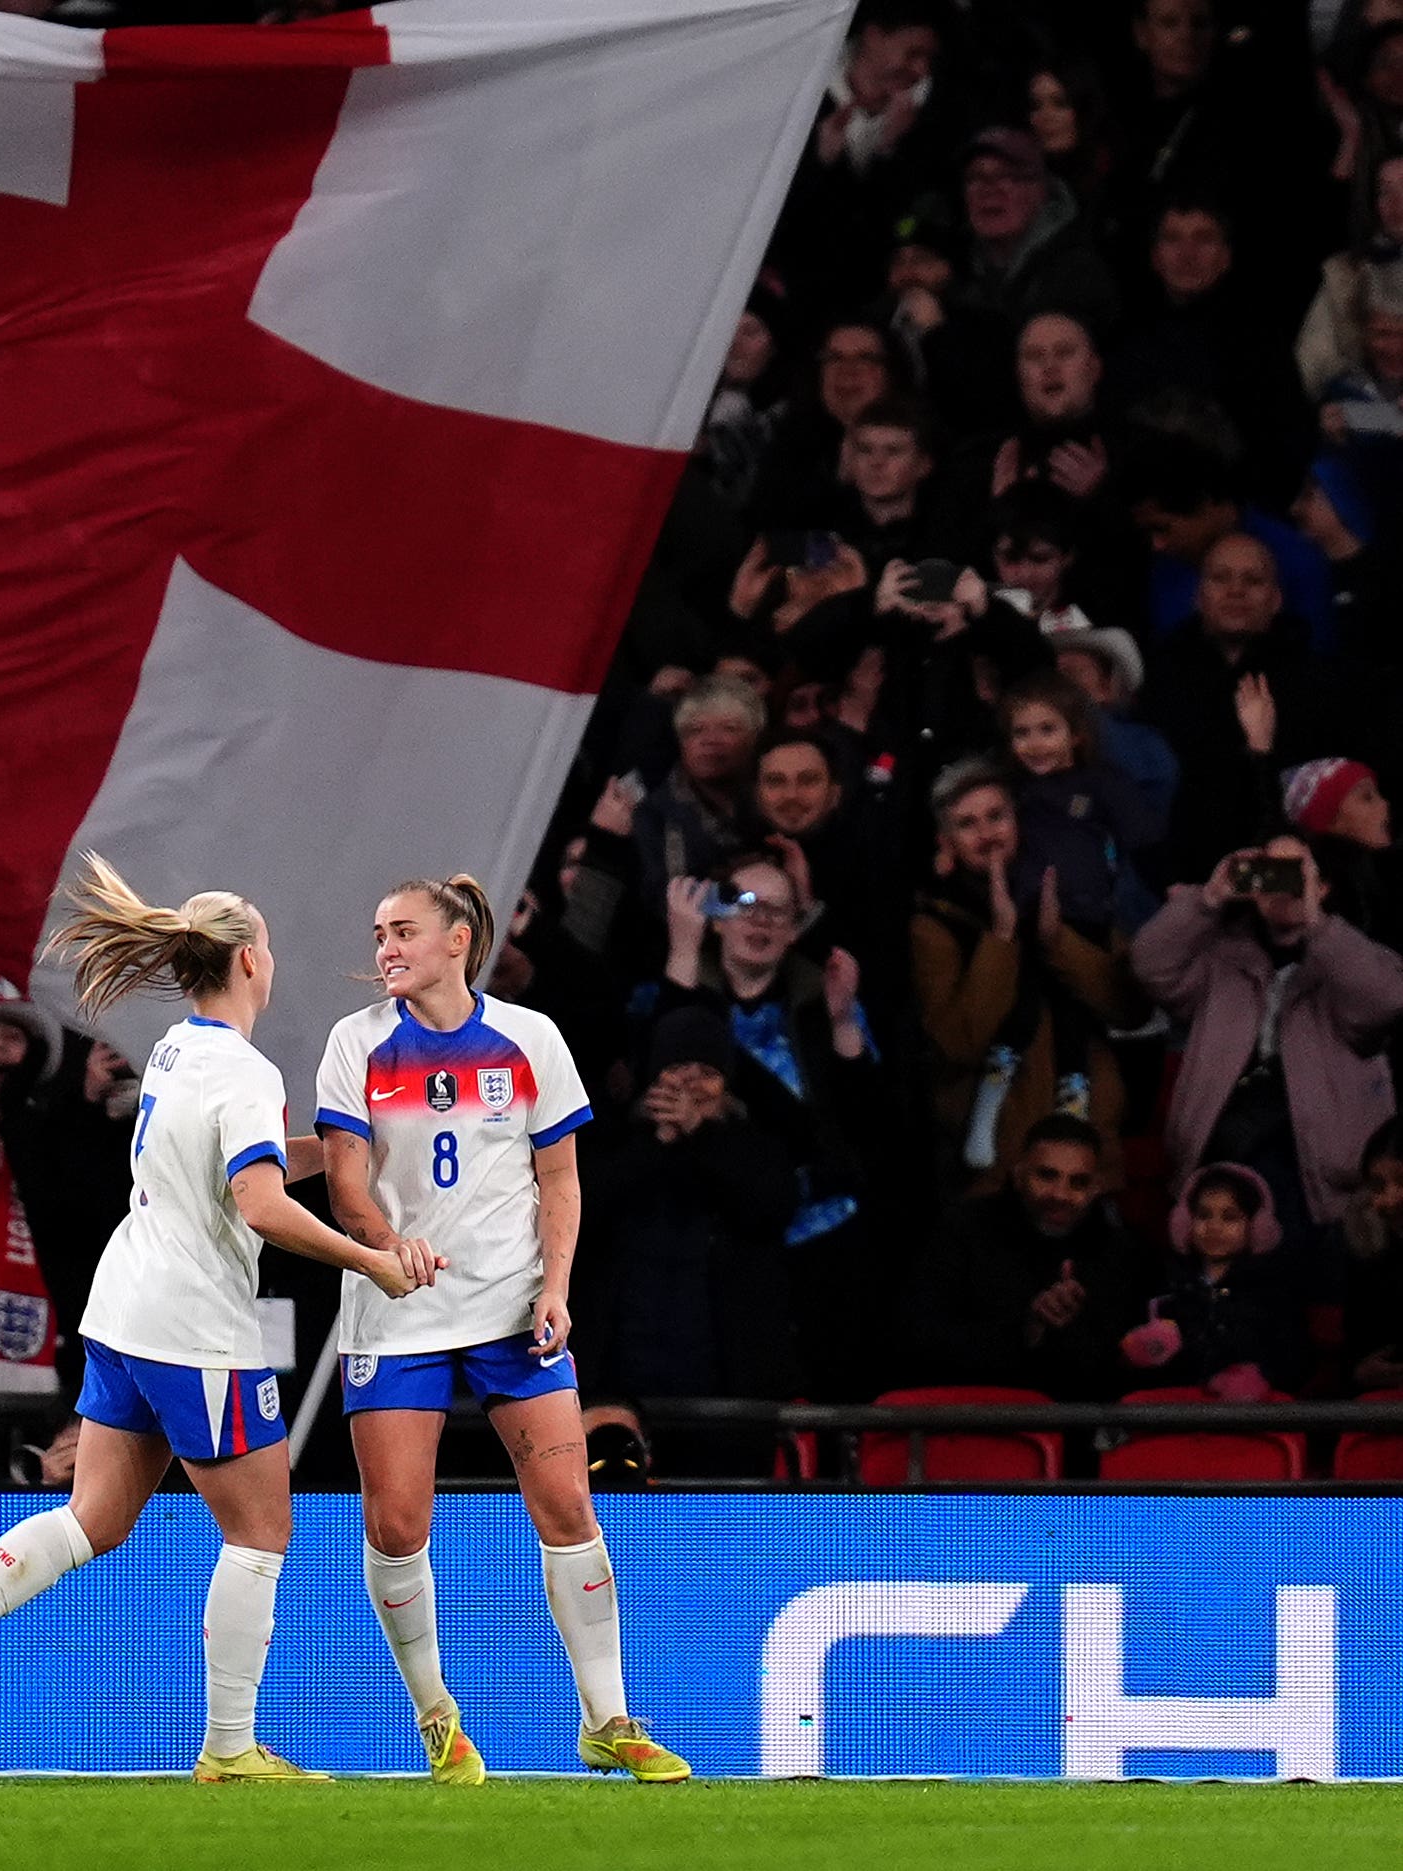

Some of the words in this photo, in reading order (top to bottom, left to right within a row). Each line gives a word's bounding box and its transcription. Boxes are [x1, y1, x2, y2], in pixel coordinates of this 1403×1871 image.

[150, 1043, 181, 1072] EAD
[135, 1092, 157, 1160] 7
[432, 1130, 459, 1189] 8
[759, 1581, 1338, 1779] CH
